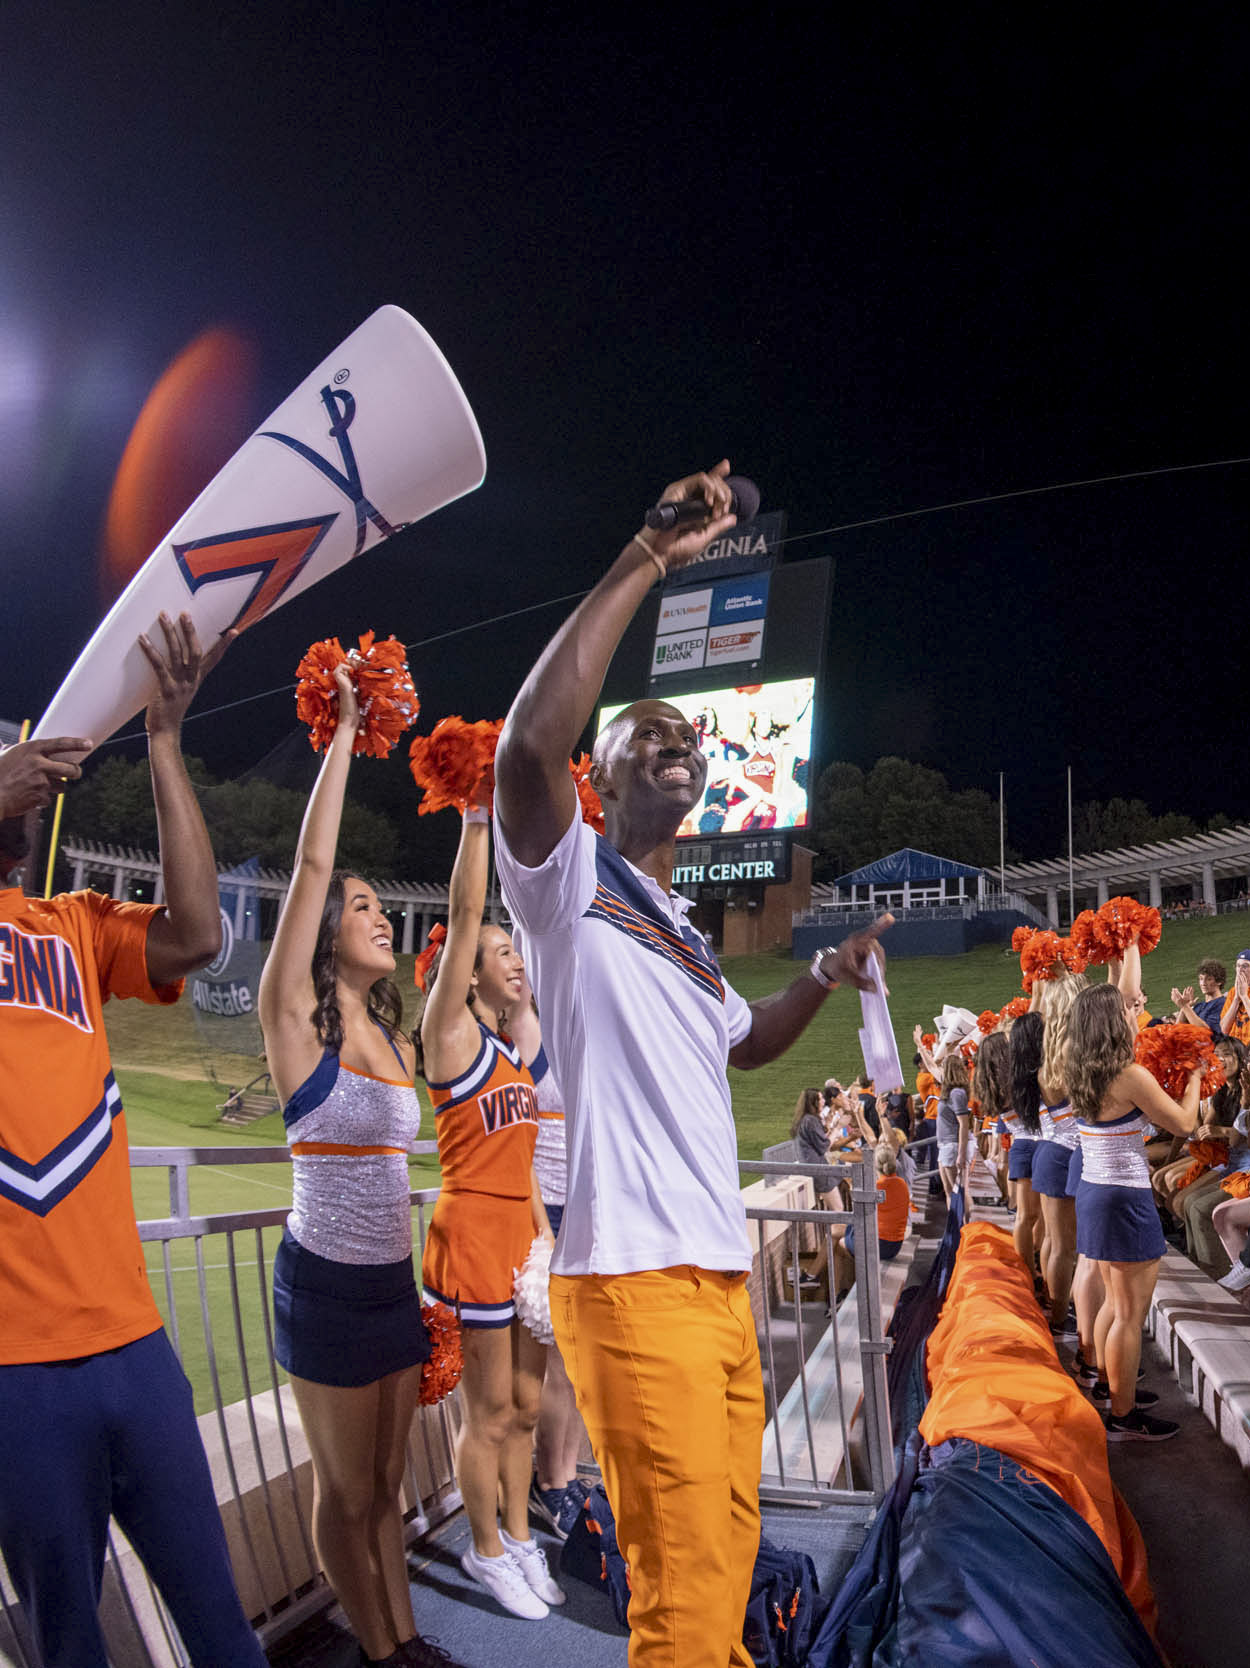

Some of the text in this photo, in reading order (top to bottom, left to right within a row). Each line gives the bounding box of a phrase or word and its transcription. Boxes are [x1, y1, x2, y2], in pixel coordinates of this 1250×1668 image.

[687, 534, 768, 566] GINIA
[666, 651, 693, 663] BANK
[667, 639, 704, 653] UNITED
[672, 860, 776, 884] ITH CENTER
[192, 980, 253, 1016] Allstate
